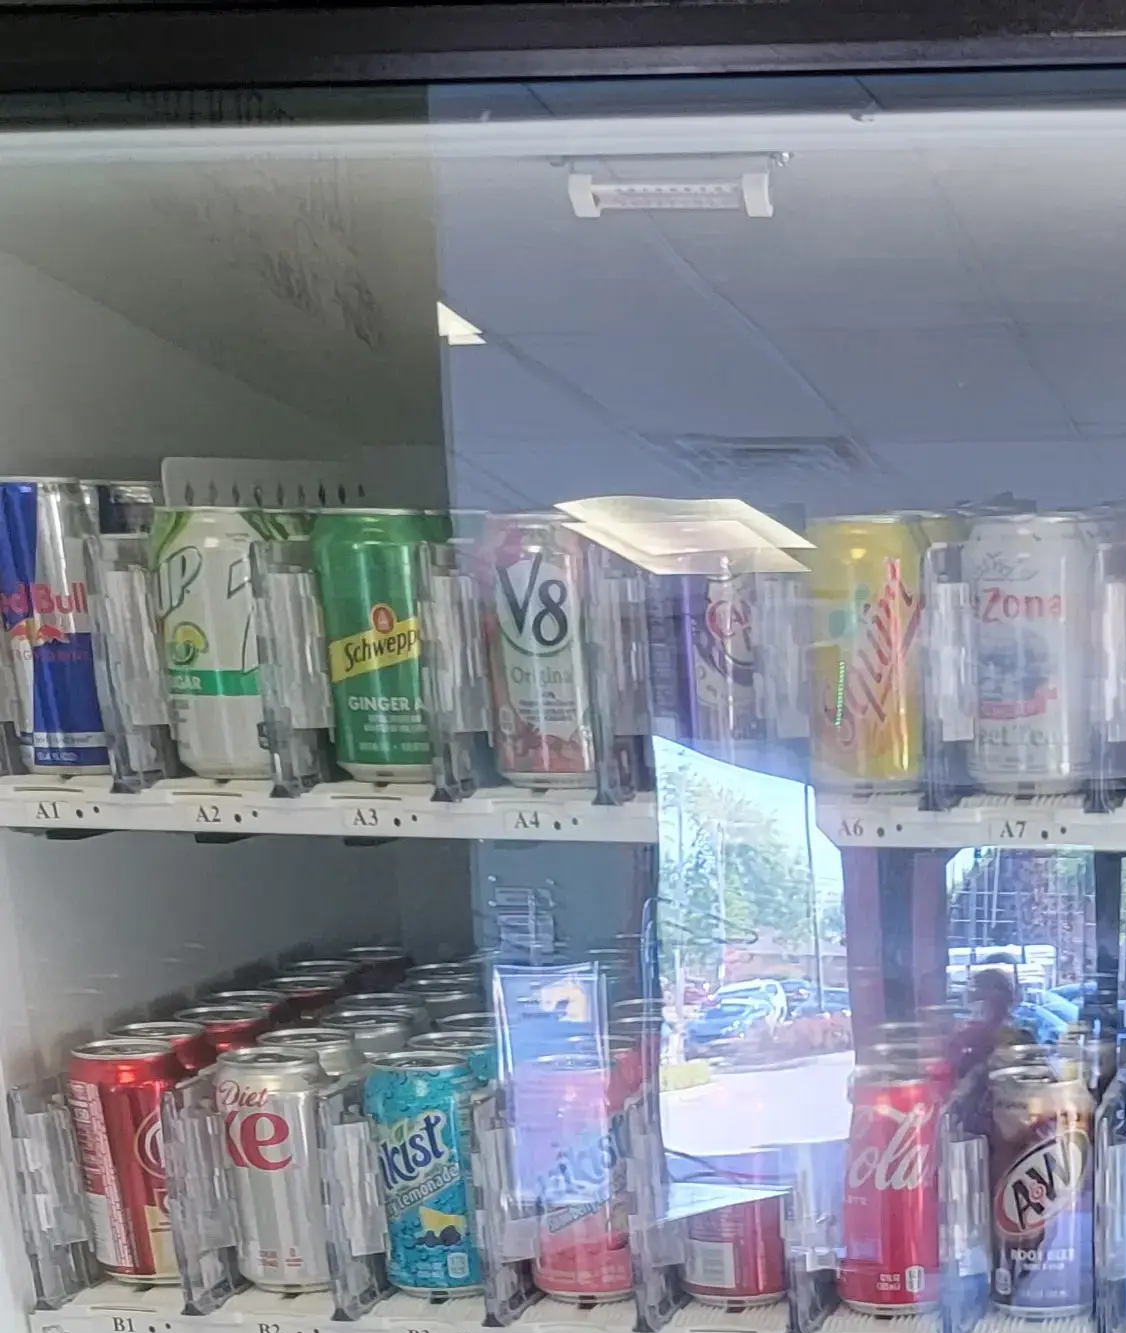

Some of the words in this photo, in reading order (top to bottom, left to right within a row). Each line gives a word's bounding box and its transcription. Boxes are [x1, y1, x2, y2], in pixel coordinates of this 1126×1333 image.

[31, 582, 88, 614] Bull
[496, 553, 568, 646] V8
[981, 586, 1064, 624] Zona
[344, 627, 420, 672] Schwepp
[349, 696, 411, 712] GINGER
[35, 800, 60, 820] A1
[195, 805, 222, 823] A2
[353, 808, 379, 827] A3
[514, 811, 541, 829] A4
[838, 818, 864, 837] A6
[999, 820, 1027, 839] A7
[218, 1079, 269, 1108] Diet
[224, 1110, 293, 1171] ke
[379, 1114, 445, 1191] kist
[399, 1163, 460, 1211] lemonade
[112, 1316, 136, 1333] B1
